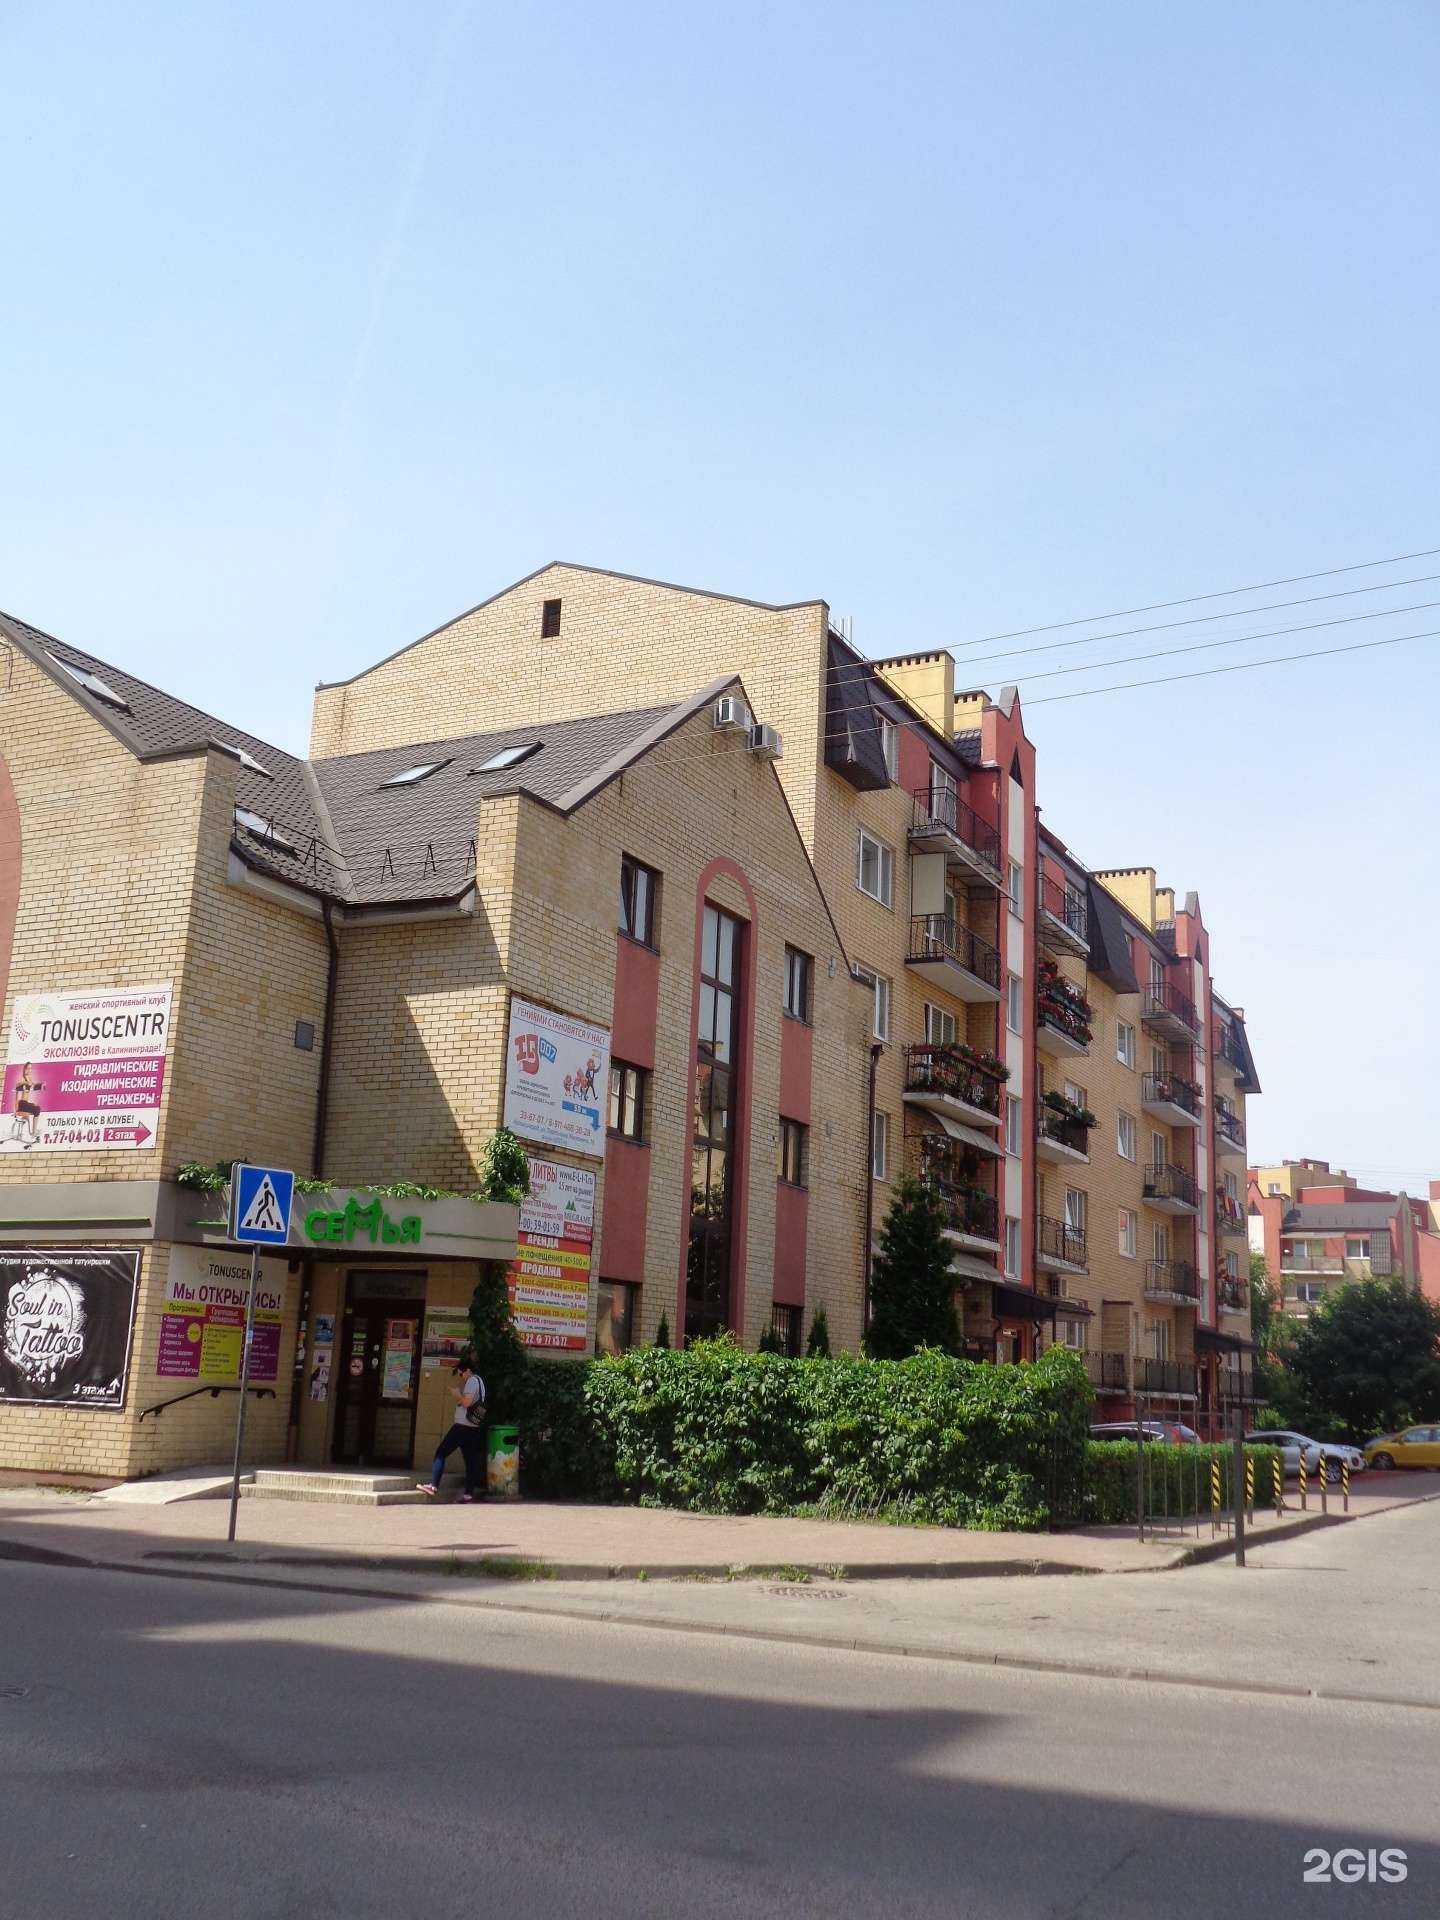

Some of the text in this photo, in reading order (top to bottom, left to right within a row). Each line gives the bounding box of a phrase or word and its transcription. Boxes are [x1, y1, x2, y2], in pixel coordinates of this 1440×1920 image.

[70, 995, 166, 1011] женский спортивный клуб
[40, 1013, 165, 1042] TONUSCENTR
[43, 1046, 100, 1058] ЭКСКЛЮЗИВ
[107, 1044, 162, 1055] Калининграде!
[73, 1061, 159, 1076] ГИДРАВЛИЧЕСКИЕ
[60, 1077, 157, 1092] ИЗОДИНАМИЧЕСКИЕ
[96, 1093, 155, 1106] ТРЕНАЖЕРЫ
[47, 1115, 135, 1126] ТОЛЬКО У НАС В КЛУБЕ!
[107, 1131, 115, 1140] 2
[114, 1131, 136, 1140] этаж
[527, 1233, 559, 1249] АРЕНДА
[0, 1257, 111, 1266] Студия художественной татуировки
[209, 1264, 263, 1282] TONUSCENR
[521, 1262, 562, 1277] ПРОДАЖА
[173, 1282, 195, 1300] Мы
[8, 1292, 63, 1316] Soul in
[19, 1320, 81, 1355] Tattoo
[73, 1384, 107, 1396] 3 этаж
